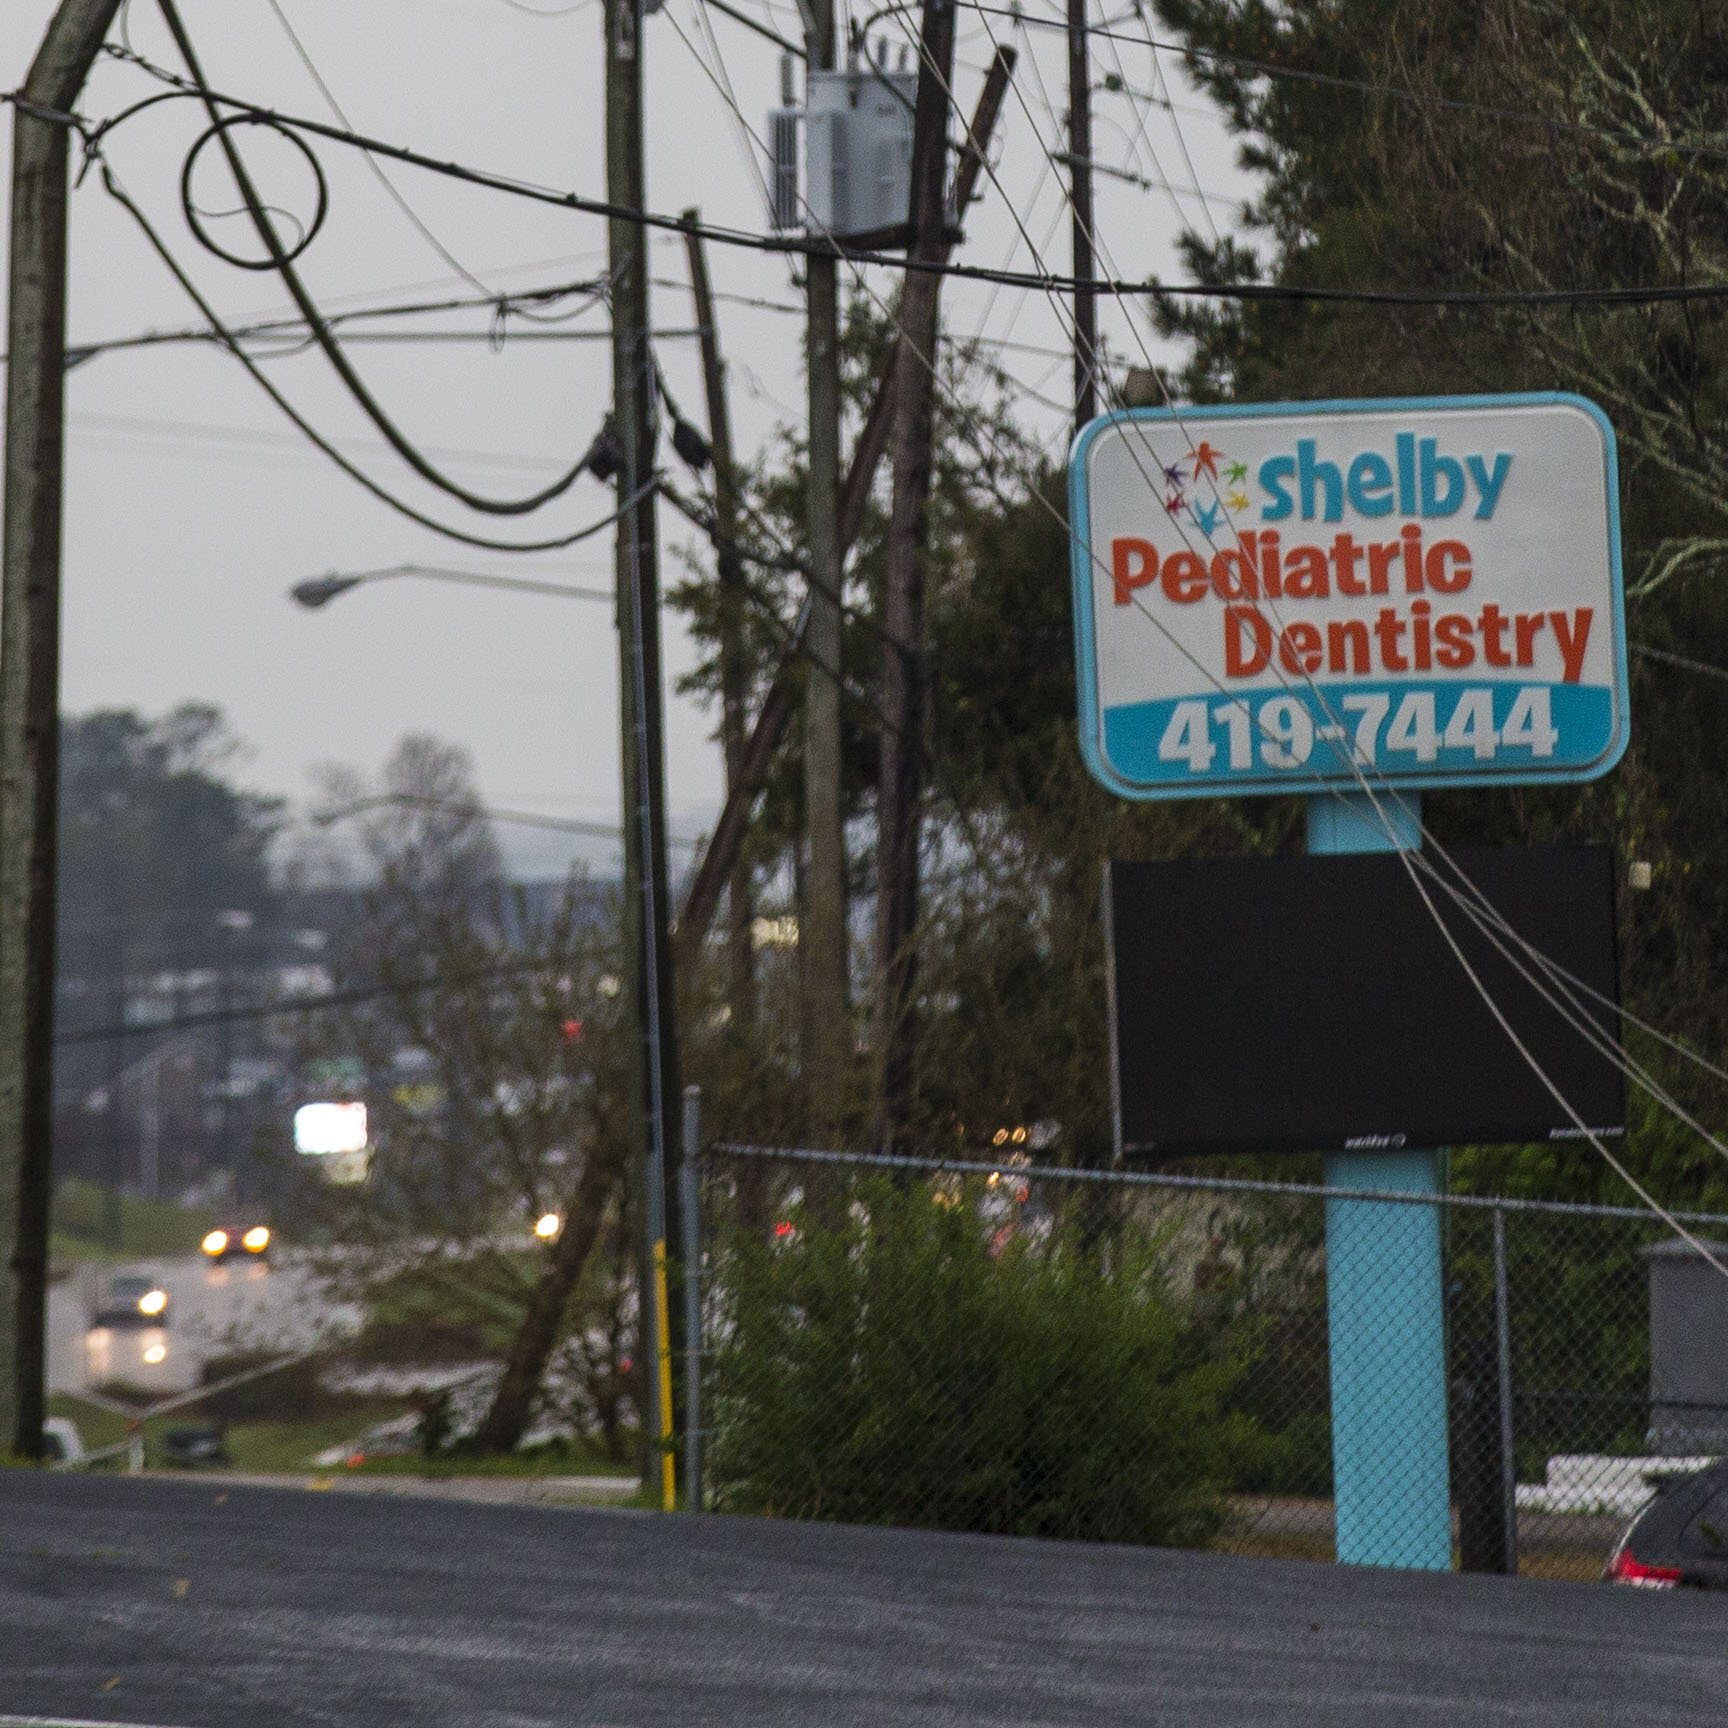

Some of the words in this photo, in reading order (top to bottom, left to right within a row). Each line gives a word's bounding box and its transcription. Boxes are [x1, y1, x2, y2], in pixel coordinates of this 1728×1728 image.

[1258, 431, 1514, 522] shelby
[1111, 523, 1473, 606] Pediatric
[1223, 599, 1594, 684] Dentistry
[1158, 687, 1559, 772] 419-7444
